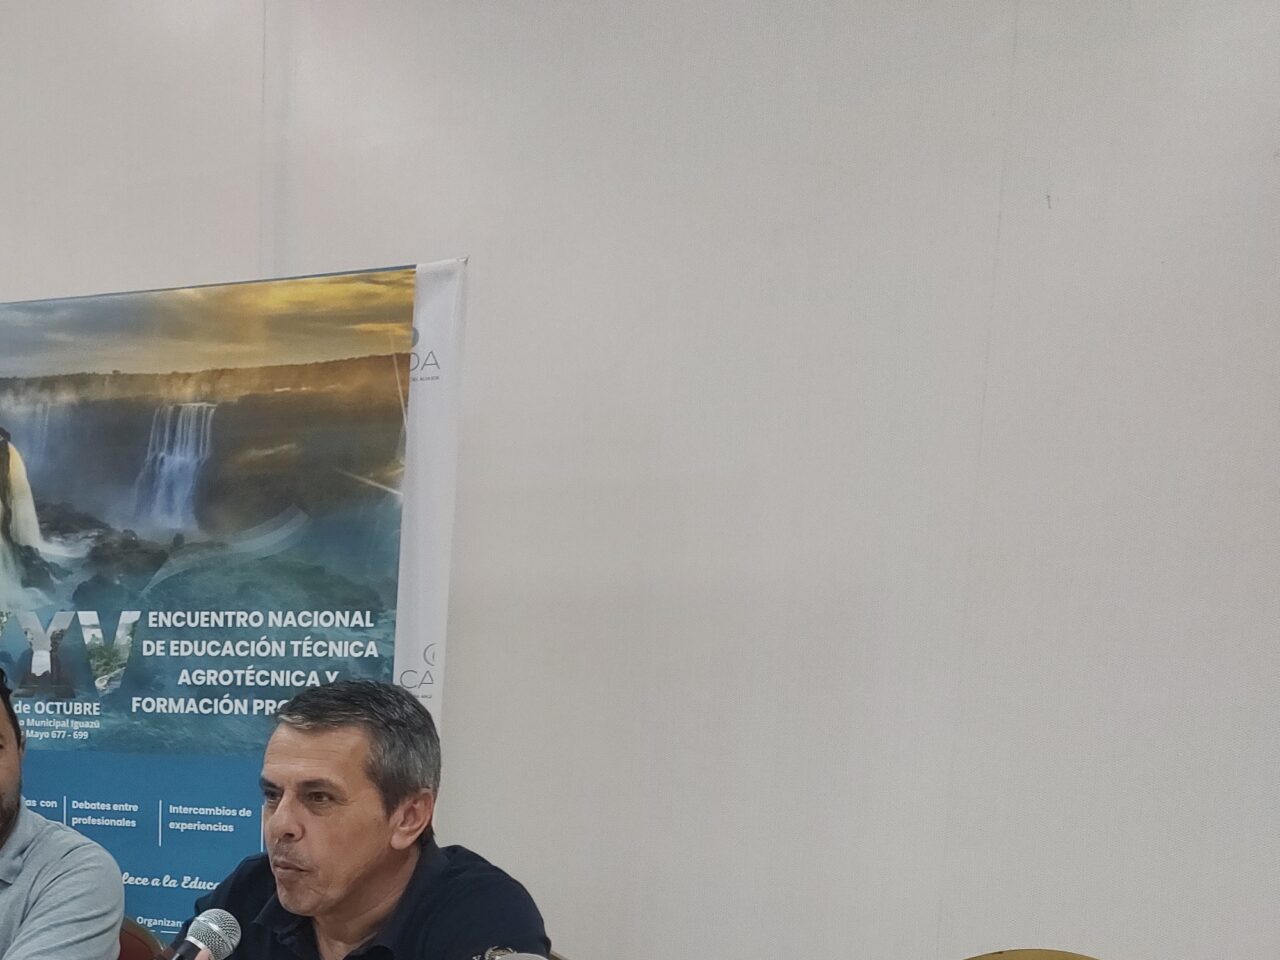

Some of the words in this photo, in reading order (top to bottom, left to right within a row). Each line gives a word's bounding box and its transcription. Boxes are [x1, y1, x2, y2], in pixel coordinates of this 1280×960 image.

[148, 611, 264, 628] ENCUENTRO
[269, 611, 374, 627] NACIONAL
[142, 640, 166, 656] DE
[170, 636, 286, 657] EDUCACIÓN
[290, 636, 379, 658] TÉCNICA
[177, 665, 320, 687] AGROTÉCNICA
[34, 701, 101, 716] OCTUBRE
[131, 694, 248, 715] FORMACIÓN
[26, 718, 69, 730] Municipal
[26, 730, 50, 741] Mayo
[51, 730, 67, 739] 677
[39, 800, 58, 809] con
[72, 800, 111, 812] Debates
[112, 802, 139, 812] entre
[169, 804, 237, 817] Intercambios
[238, 809, 252, 817] de
[71, 816, 137, 828] profesionales
[169, 821, 234, 832] experiencias
[162, 875, 178, 888] la
